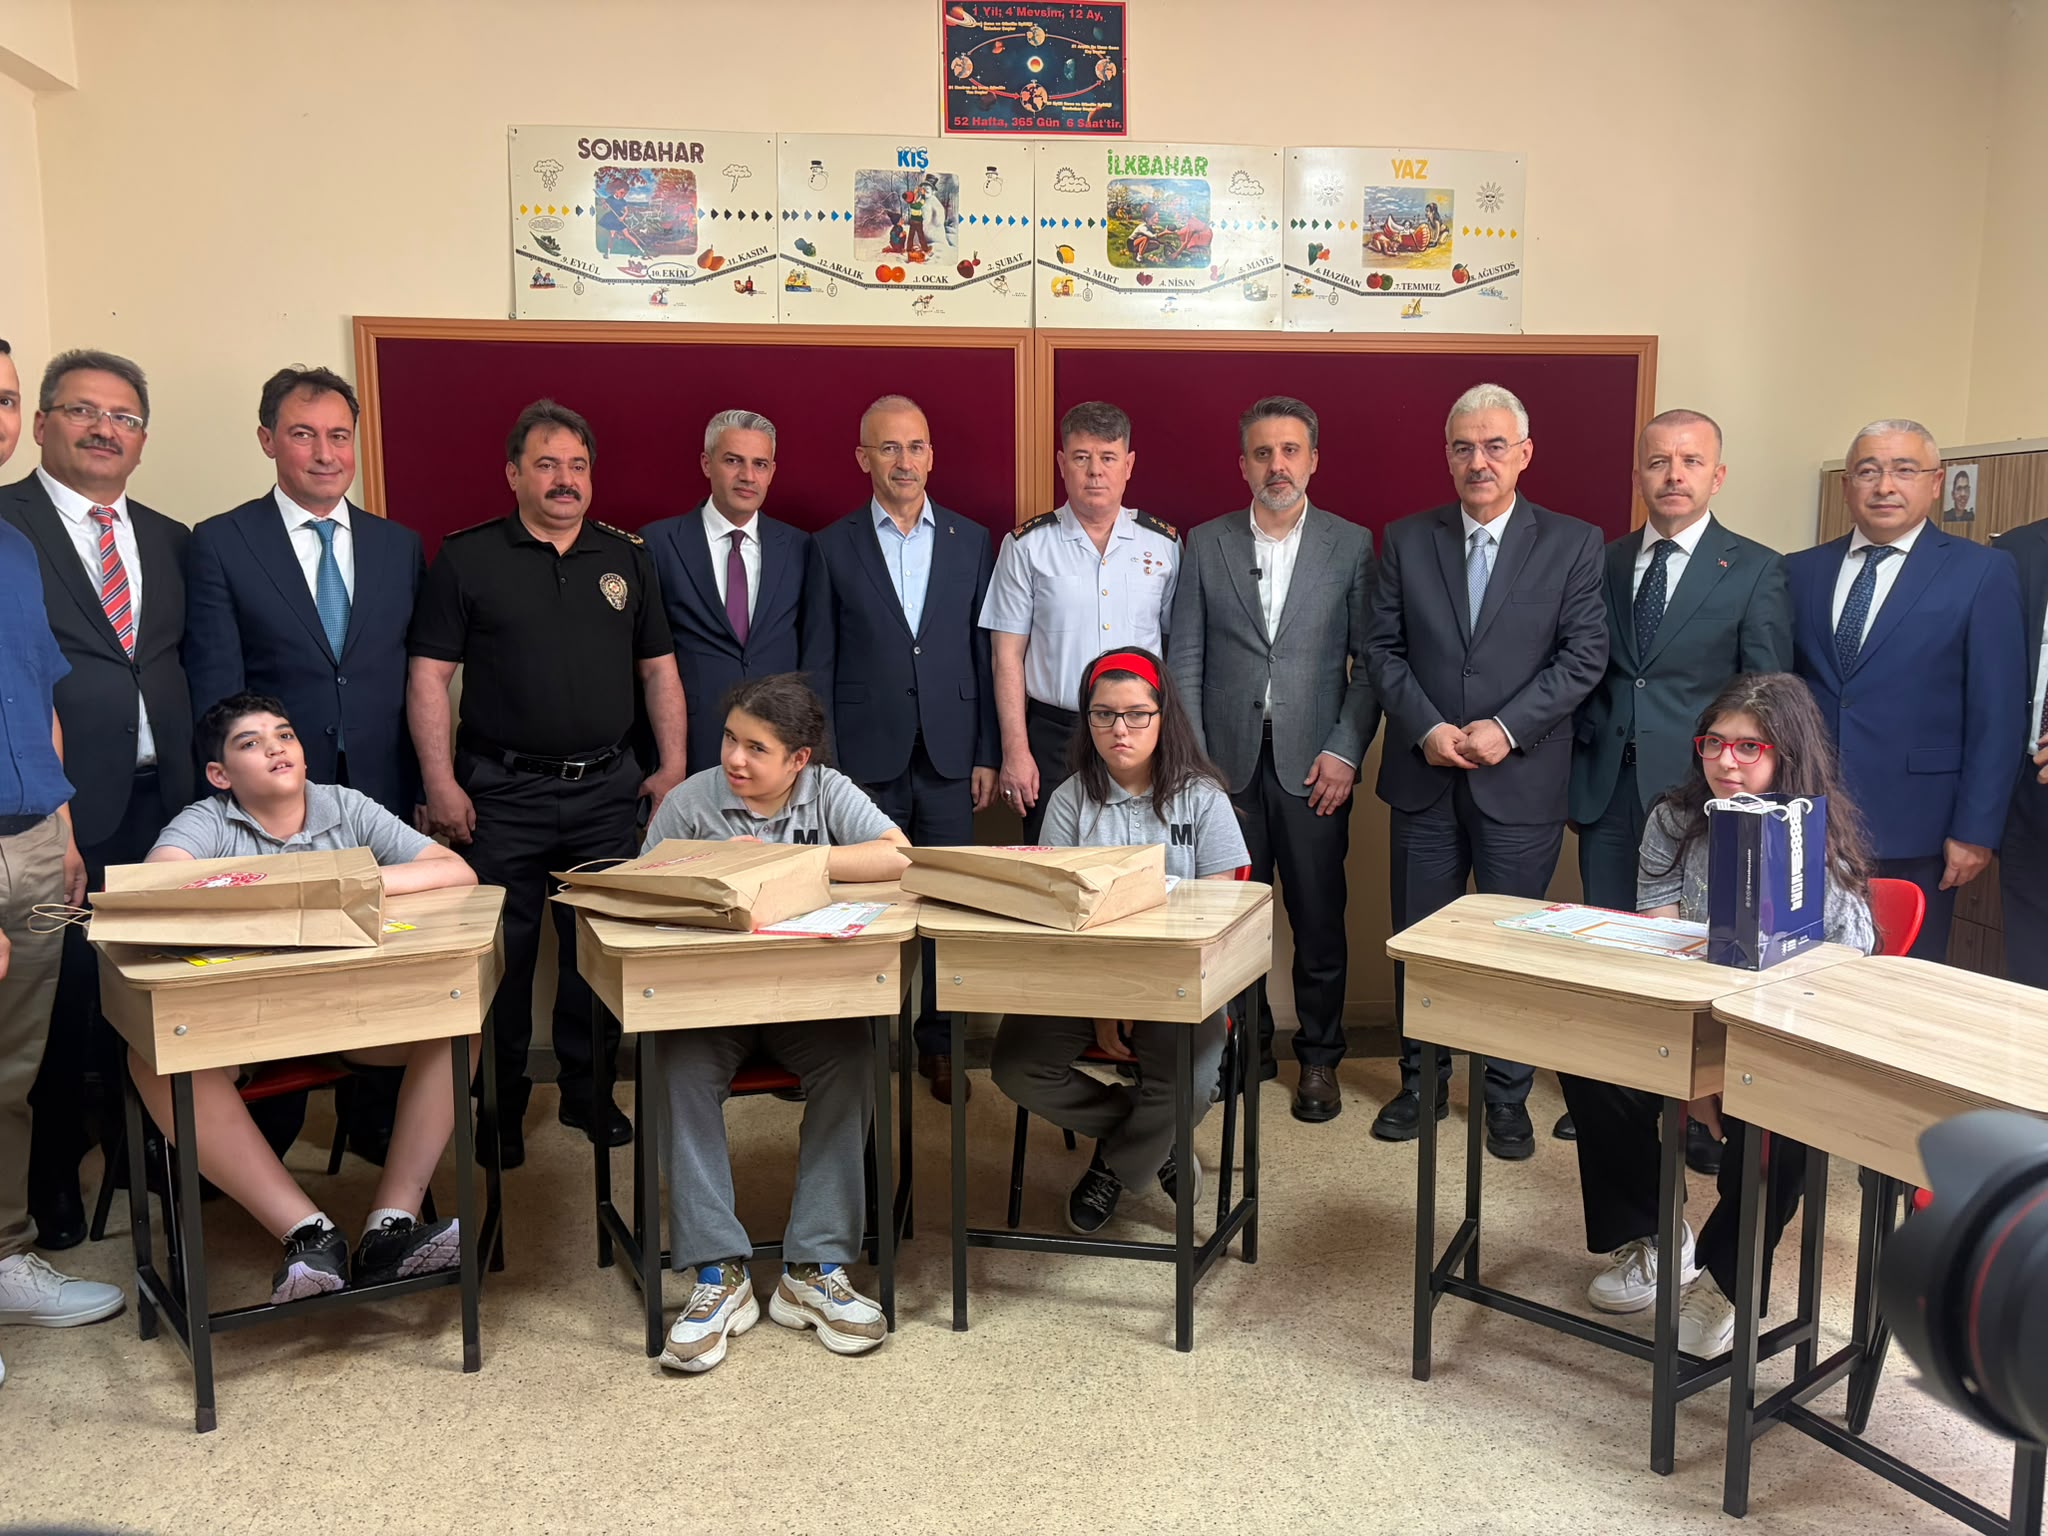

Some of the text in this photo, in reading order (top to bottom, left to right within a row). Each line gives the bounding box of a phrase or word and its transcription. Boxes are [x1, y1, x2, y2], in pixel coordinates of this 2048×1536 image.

[972, 7, 979, 16] 1
[1005, 7, 1013, 16] 4
[1069, 9, 1083, 19] 12
[1086, 10, 1104, 21] Ay,
[954, 117, 969, 126] 52
[972, 117, 1008, 128] Hafta,
[1011, 117, 1033, 127] 365
[1037, 117, 1060, 127] Gün
[1067, 118, 1074, 128] 6
[578, 137, 705, 163] SONBAHAR
[1107, 149, 1209, 176] İLKBAHAR
[1391, 159, 1429, 180] YAZ
[738, 245, 769, 262] KASIM
[994, 253, 1024, 270] ŞUBAT
[570, 258, 601, 276] EYLÜL
[829, 262, 864, 280] ARALIK
[1246, 255, 1274, 271] MAYIS
[1478, 261, 1516, 280] AĞUSTOS
[662, 268, 689, 278] EKİM
[921, 275, 948, 284] OCAK
[1092, 269, 1120, 284] MART
[1322, 268, 1362, 288] HAZİRAN
[1168, 277, 1196, 287] NİSAN
[1401, 283, 1441, 291] TEMMUZ
[793, 829, 819, 845] M
[1170, 824, 1192, 846] M
